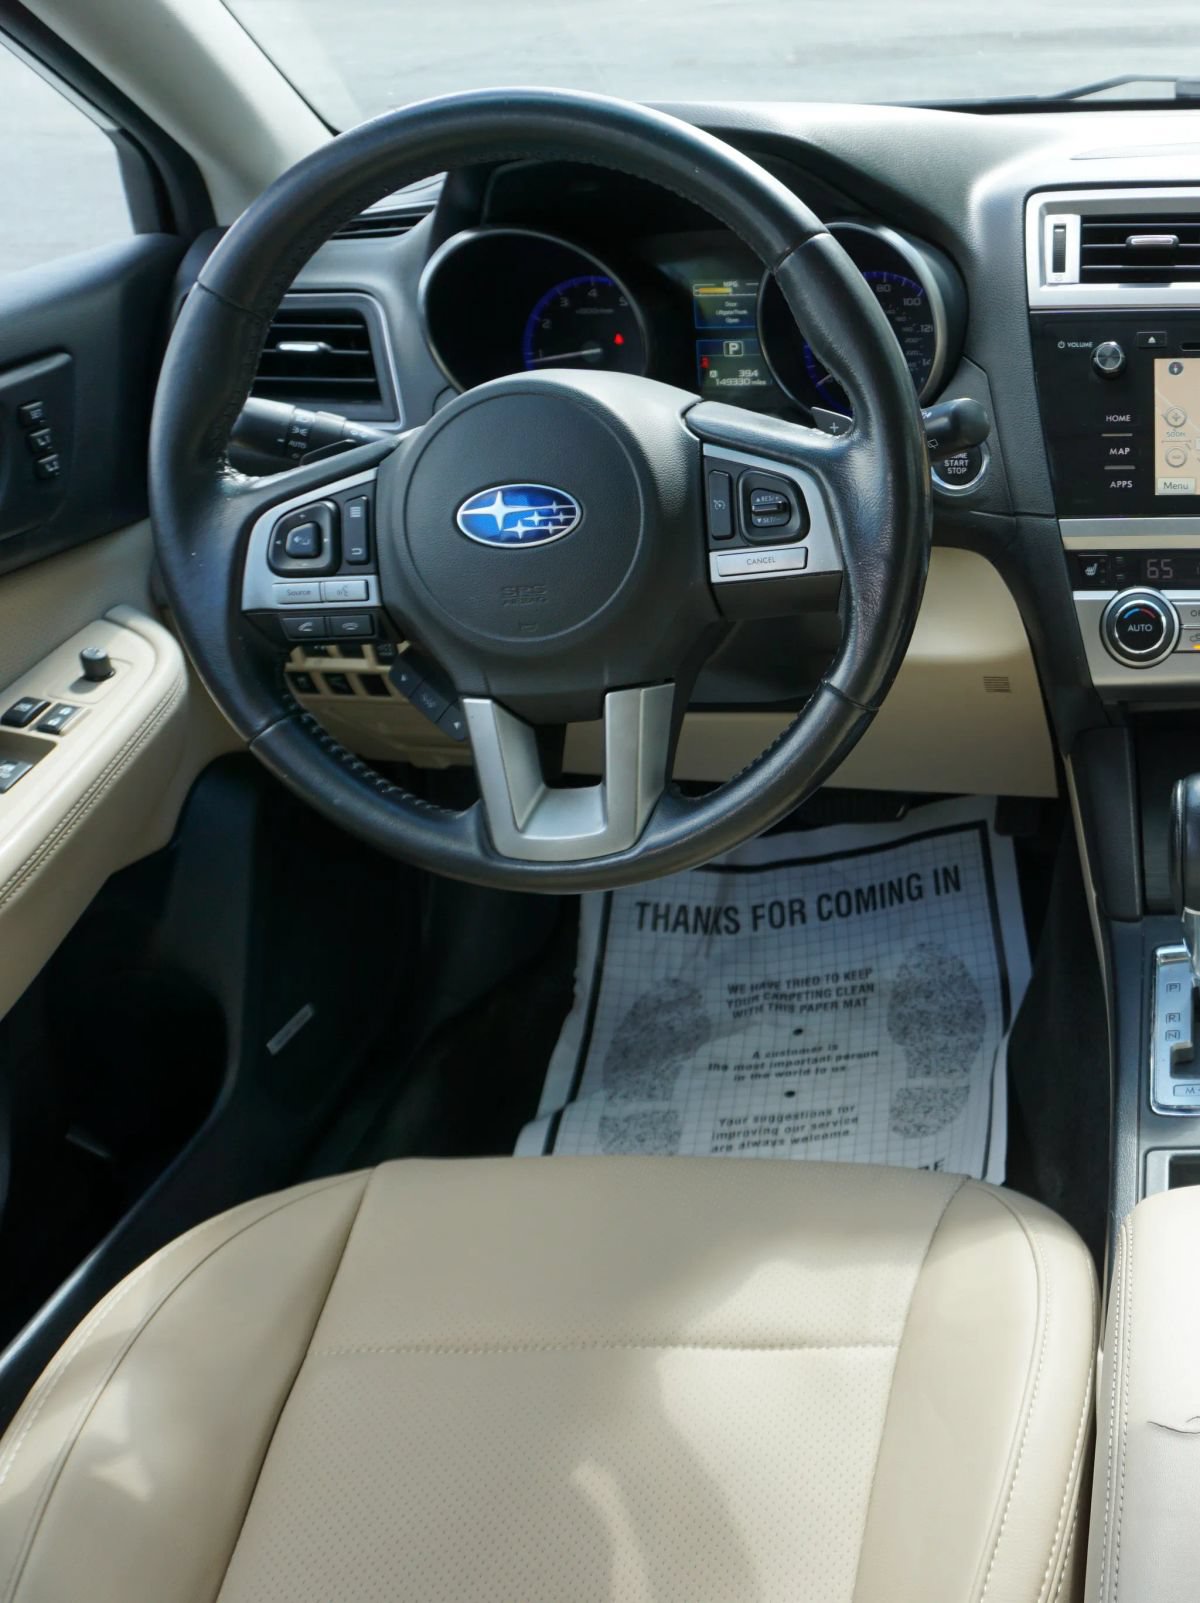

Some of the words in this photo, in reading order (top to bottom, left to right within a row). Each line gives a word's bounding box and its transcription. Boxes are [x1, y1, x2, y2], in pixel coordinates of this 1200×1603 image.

[587, 288, 598, 298] 4
[559, 297, 569, 307] 3
[903, 298, 921, 306] 100
[541, 318, 552, 329] 2
[728, 343, 738, 355] P
[1105, 414, 1132, 422] HOME
[1109, 447, 1131, 455] MAP
[943, 459, 969, 467] START
[1109, 480, 1133, 488] APPS
[1163, 481, 1189, 490] Menu
[746, 556, 776, 565] CANCEL
[1146, 558, 1174, 579] 65
[1127, 623, 1153, 632] AUTO
[635, 901, 740, 935] THANKS
[752, 897, 806, 931] FOR
[816, 872, 923, 922] COMING
[933, 864, 961, 897] IN
[727, 983, 746, 995] WE
[750, 980, 781, 993] HAVE
[785, 975, 821, 989] TRIED
[825, 972, 840, 984] TO
[843, 967, 873, 980] KEEP
[1169, 984, 1178, 992] P
[726, 993, 760, 1009] YOUR
[763, 987, 832, 1002] CARPETING
[836, 983, 875, 997] CLEAN
[732, 1003, 764, 1019] WITH
[767, 1002, 795, 1014] THIS
[799, 1000, 839, 1014] PAPER
[843, 996, 868, 1009] MAT
[1168, 1014, 1177, 1023] R
[1167, 1031, 1177, 1039] N
[752, 1051, 760, 1059] A
[765, 1045, 823, 1059] customer
[708, 1062, 729, 1072] the
[733, 1061, 765, 1072] most
[769, 1054, 831, 1070] important
[835, 1049, 879, 1062] person
[750, 1071, 770, 1080] the
[774, 1067, 811, 1079] world
[815, 1066, 827, 1075] to
[720, 1116, 748, 1127] Your
[753, 1107, 832, 1124] suggestions
[838, 1104, 856, 1115] for
[712, 1126, 779, 1142] improving
[784, 1124, 806, 1134] our
[810, 1116, 858, 1131] service
[711, 1143, 733, 1153] are
[738, 1136, 785, 1152] always
[790, 1128, 850, 1146] welcome
